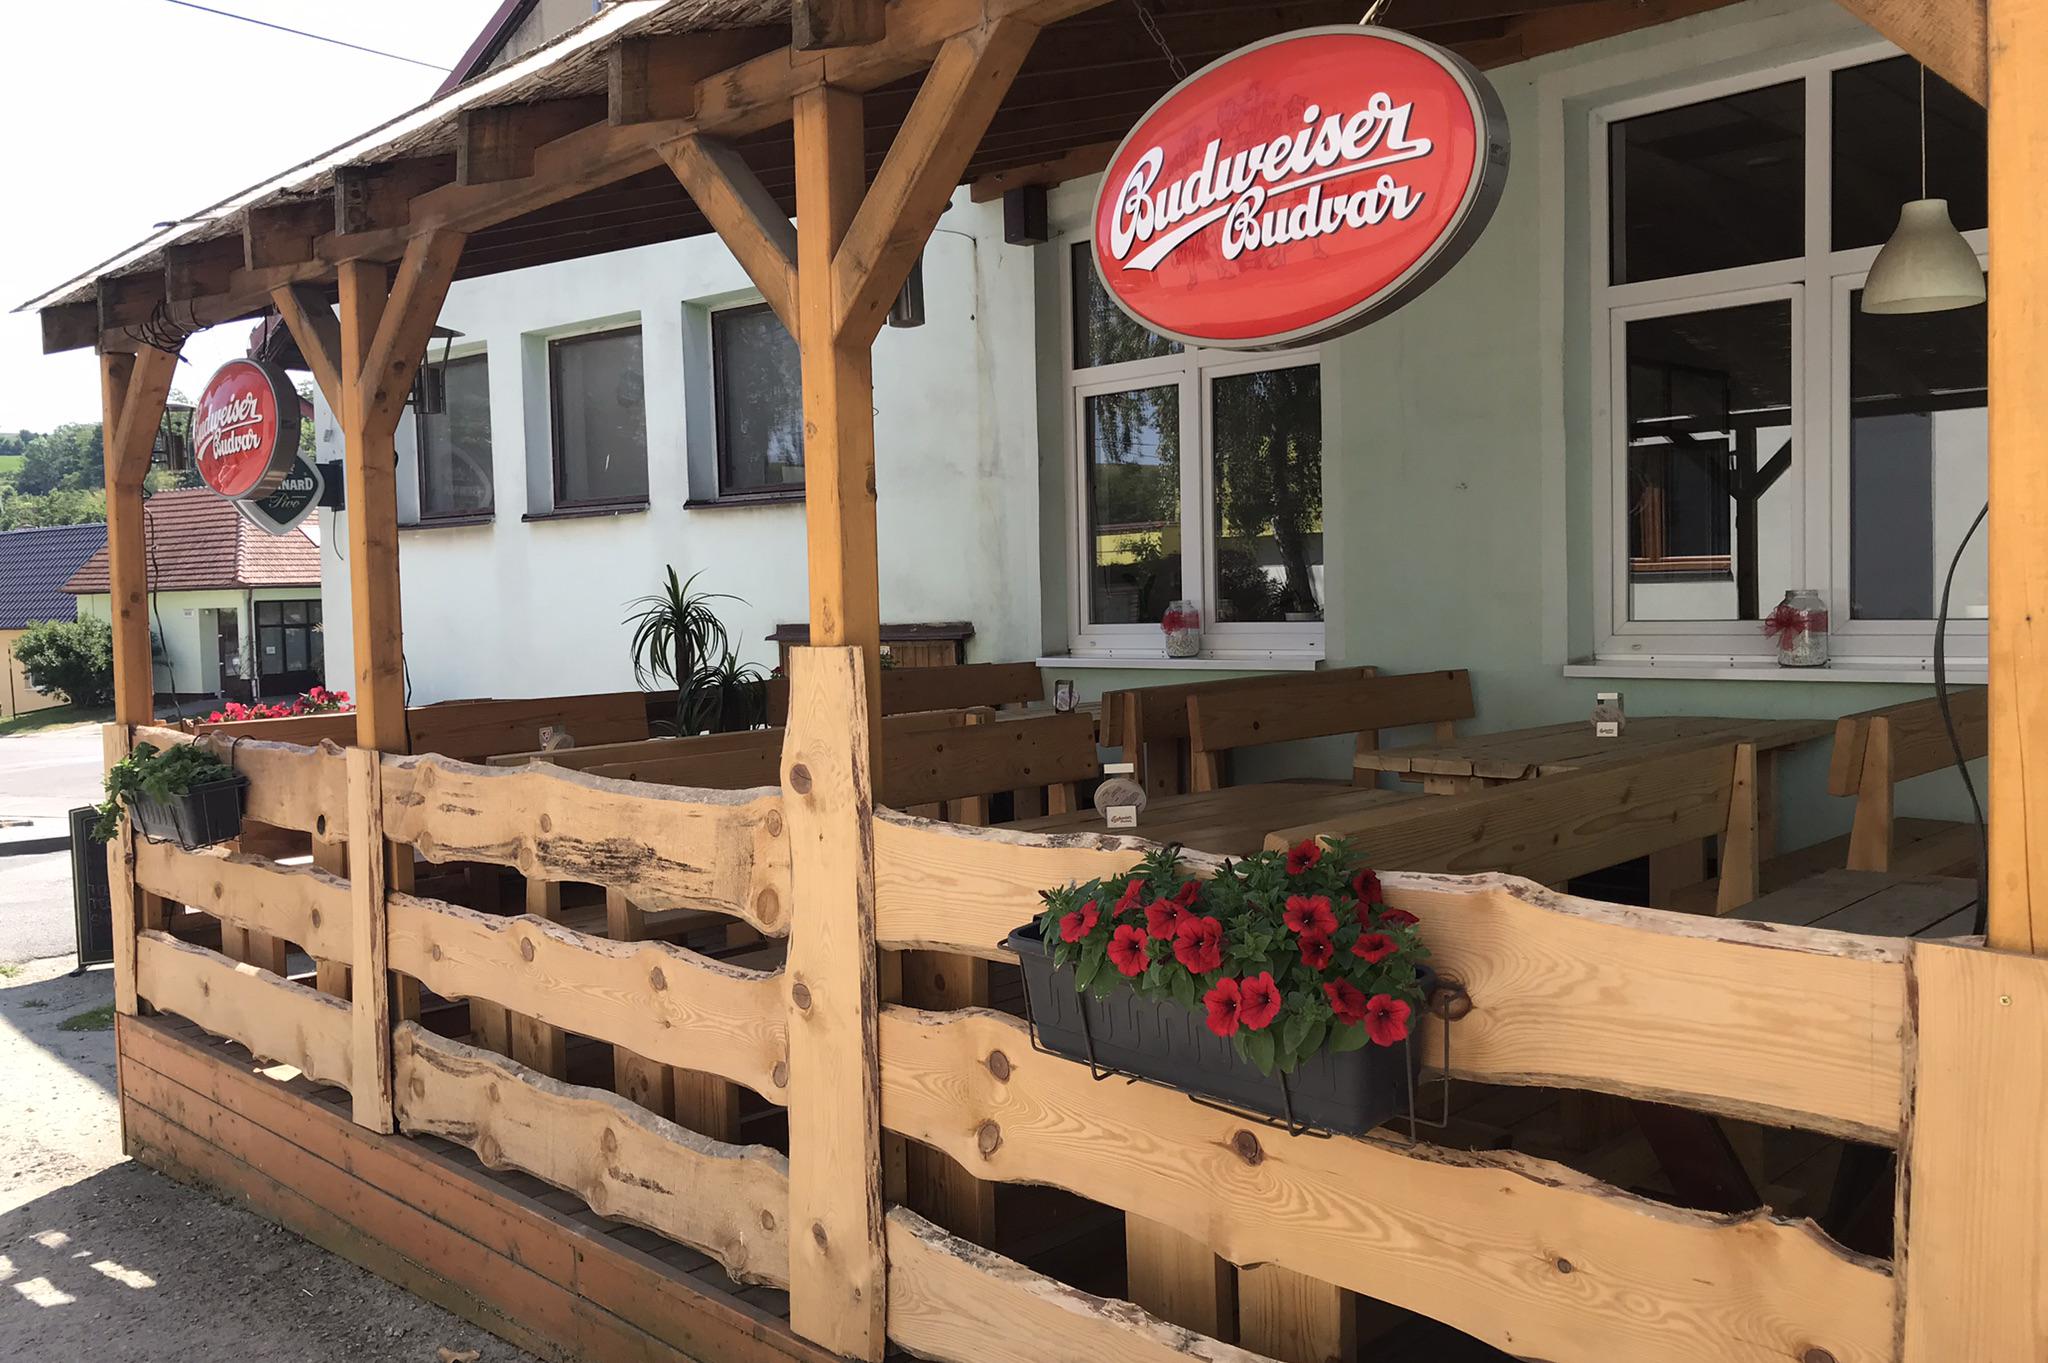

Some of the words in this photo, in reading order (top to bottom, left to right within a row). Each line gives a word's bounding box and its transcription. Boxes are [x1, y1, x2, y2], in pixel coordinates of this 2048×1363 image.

[1111, 92, 1432, 262] Budweiser
[1222, 175, 1425, 260] Budvar
[213, 428, 261, 460] Budvar
[278, 477, 314, 491] NARD
